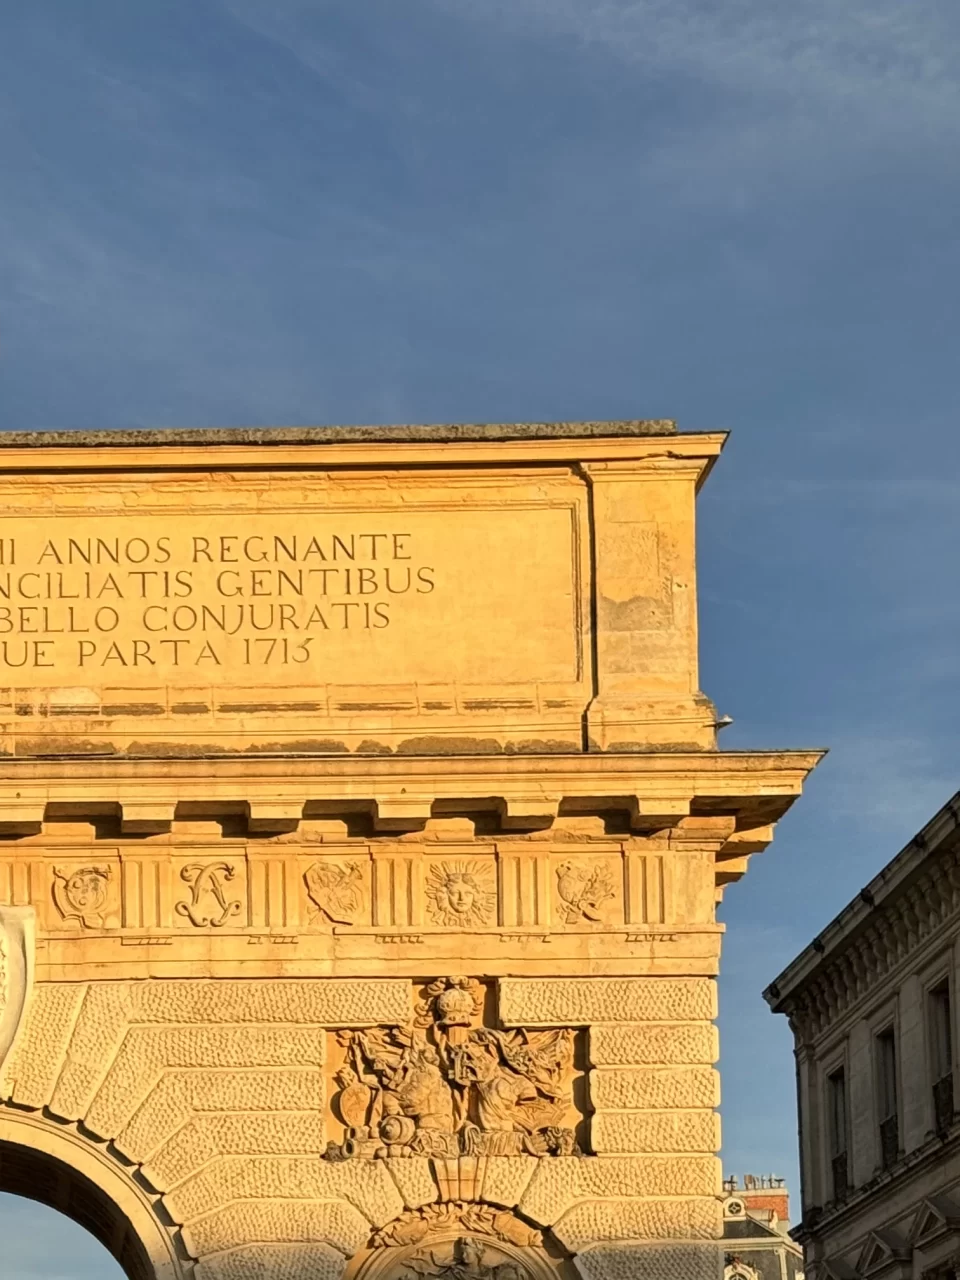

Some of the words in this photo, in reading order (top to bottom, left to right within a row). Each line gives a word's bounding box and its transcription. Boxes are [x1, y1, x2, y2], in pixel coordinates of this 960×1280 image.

[37, 537, 171, 565] ANNOS
[192, 533, 412, 563] REGNANTE
[216, 567, 435, 597] GENTIBUS
[143, 602, 390, 635] CONJURATIS
[78, 639, 221, 667] PARTA
